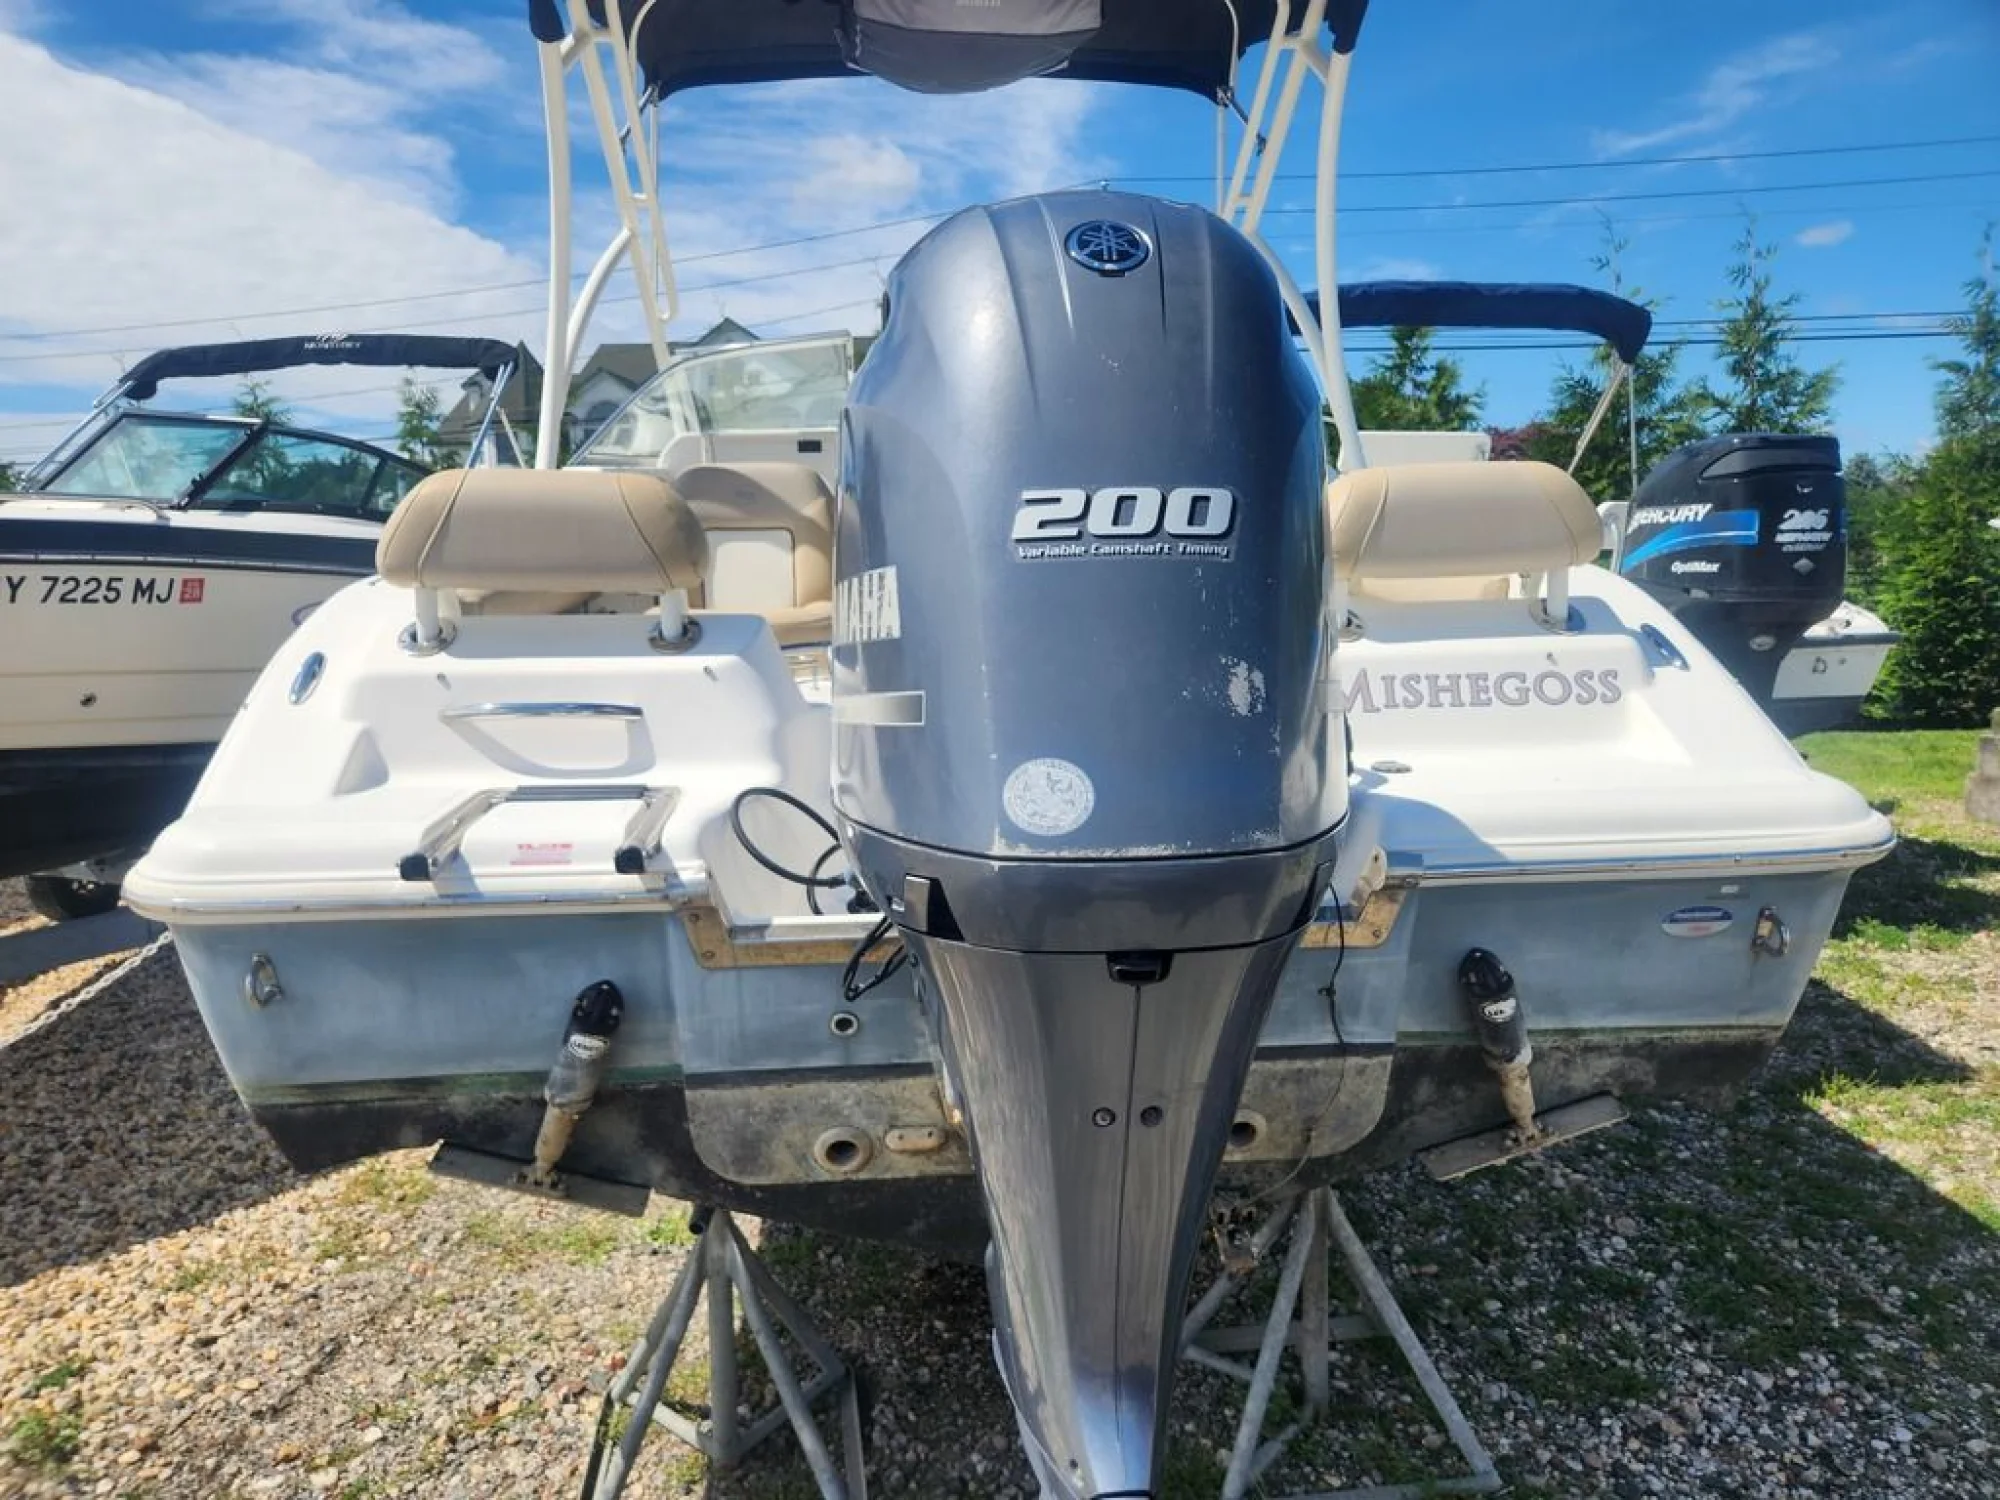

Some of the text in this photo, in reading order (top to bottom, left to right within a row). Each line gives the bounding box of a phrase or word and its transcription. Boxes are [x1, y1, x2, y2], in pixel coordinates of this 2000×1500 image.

[1012, 487, 1235, 542] 200
[1019, 542, 1230, 562] Variable Camshaft Timing
[40, 576, 124, 604] 7225
[132, 577, 175, 604] MJ
